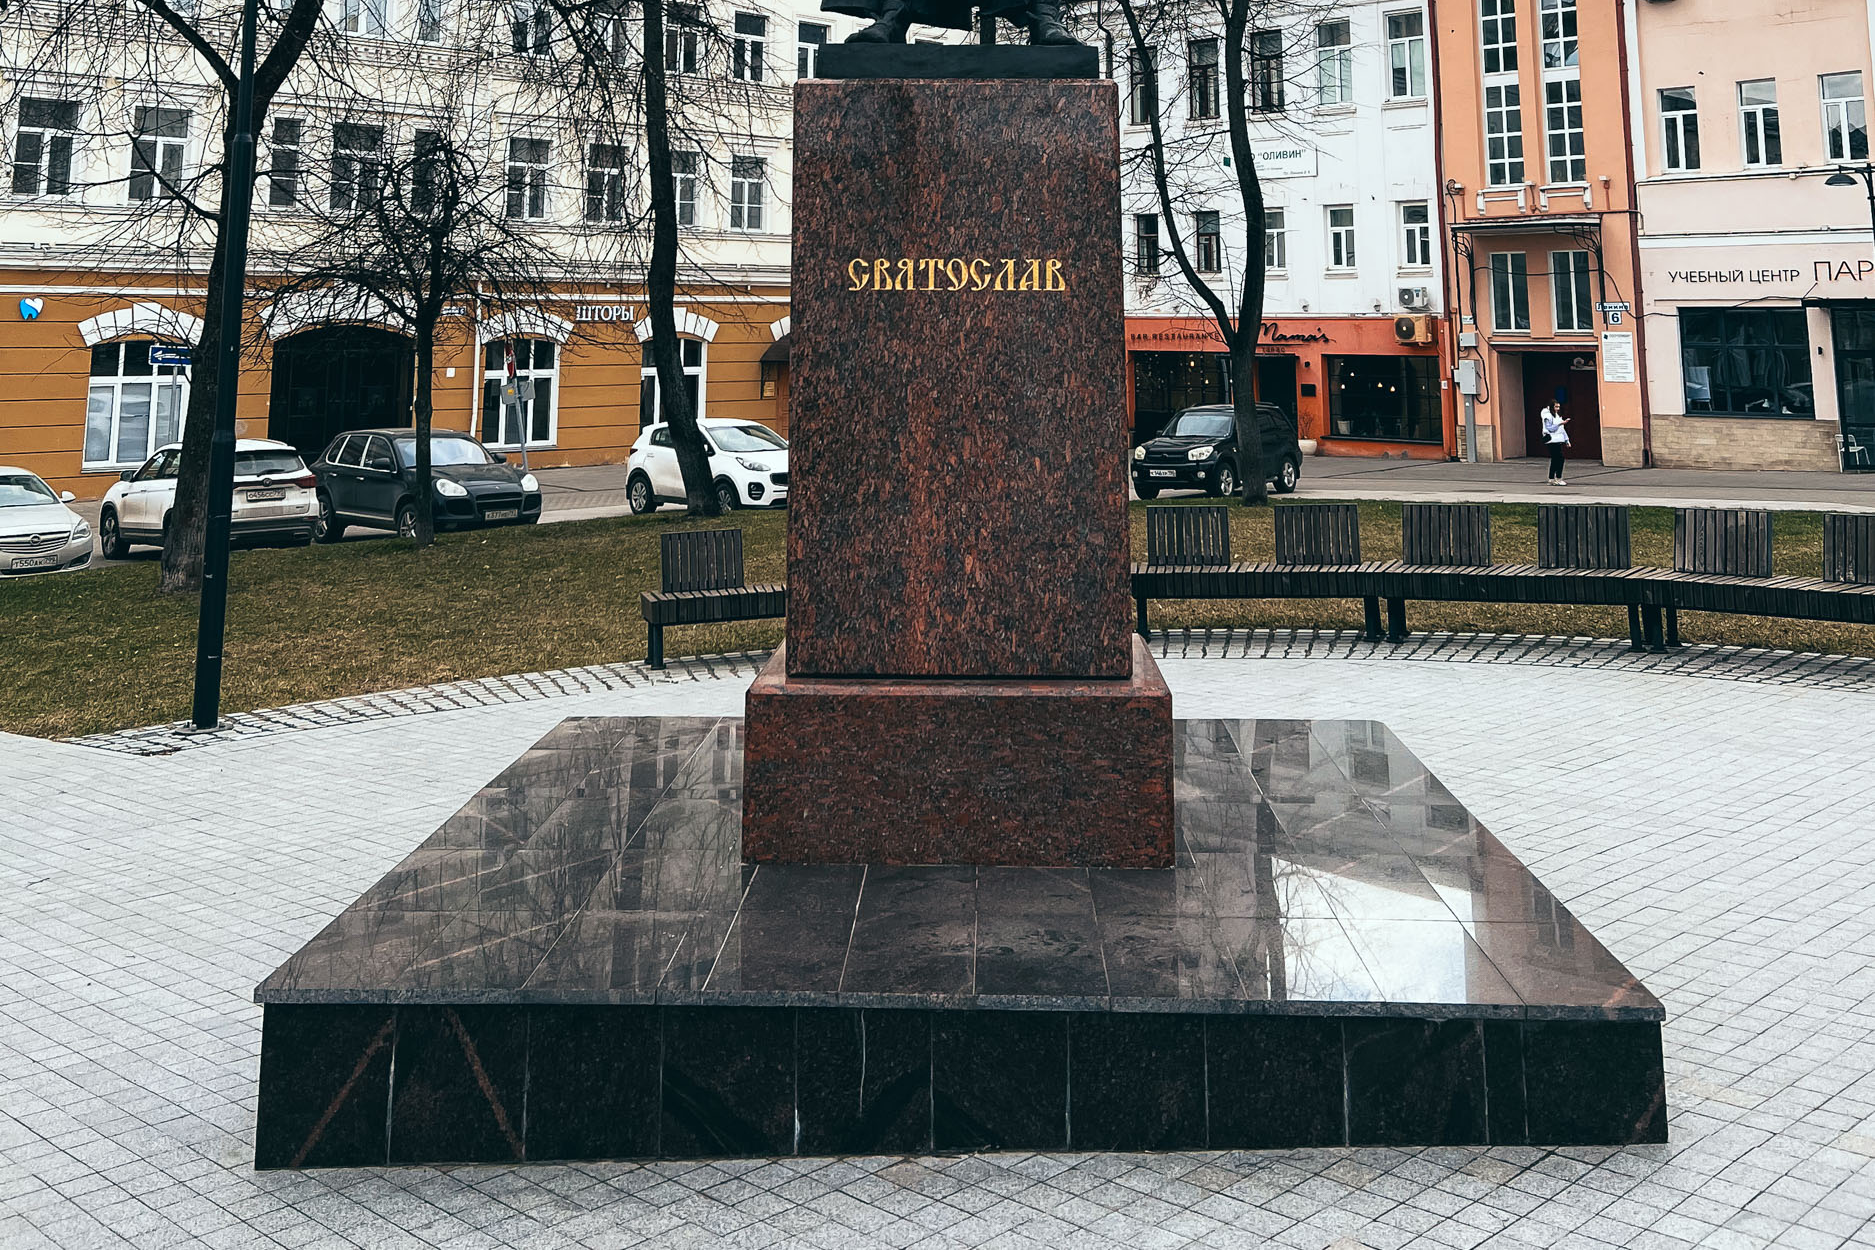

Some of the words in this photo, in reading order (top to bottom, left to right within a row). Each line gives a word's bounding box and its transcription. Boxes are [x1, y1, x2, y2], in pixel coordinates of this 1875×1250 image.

[848, 258, 1066, 291] СВЯТОСЛАВ
[1668, 269, 1744, 283] УЧЕБНЫЙ
[1750, 269, 1800, 284] ЦЕНТР
[1813, 260, 1874, 282] ПАР
[576, 305, 635, 321] ШТОРЫ
[1611, 312, 1620, 323] 6
[1130, 333, 1148, 341] BAR
